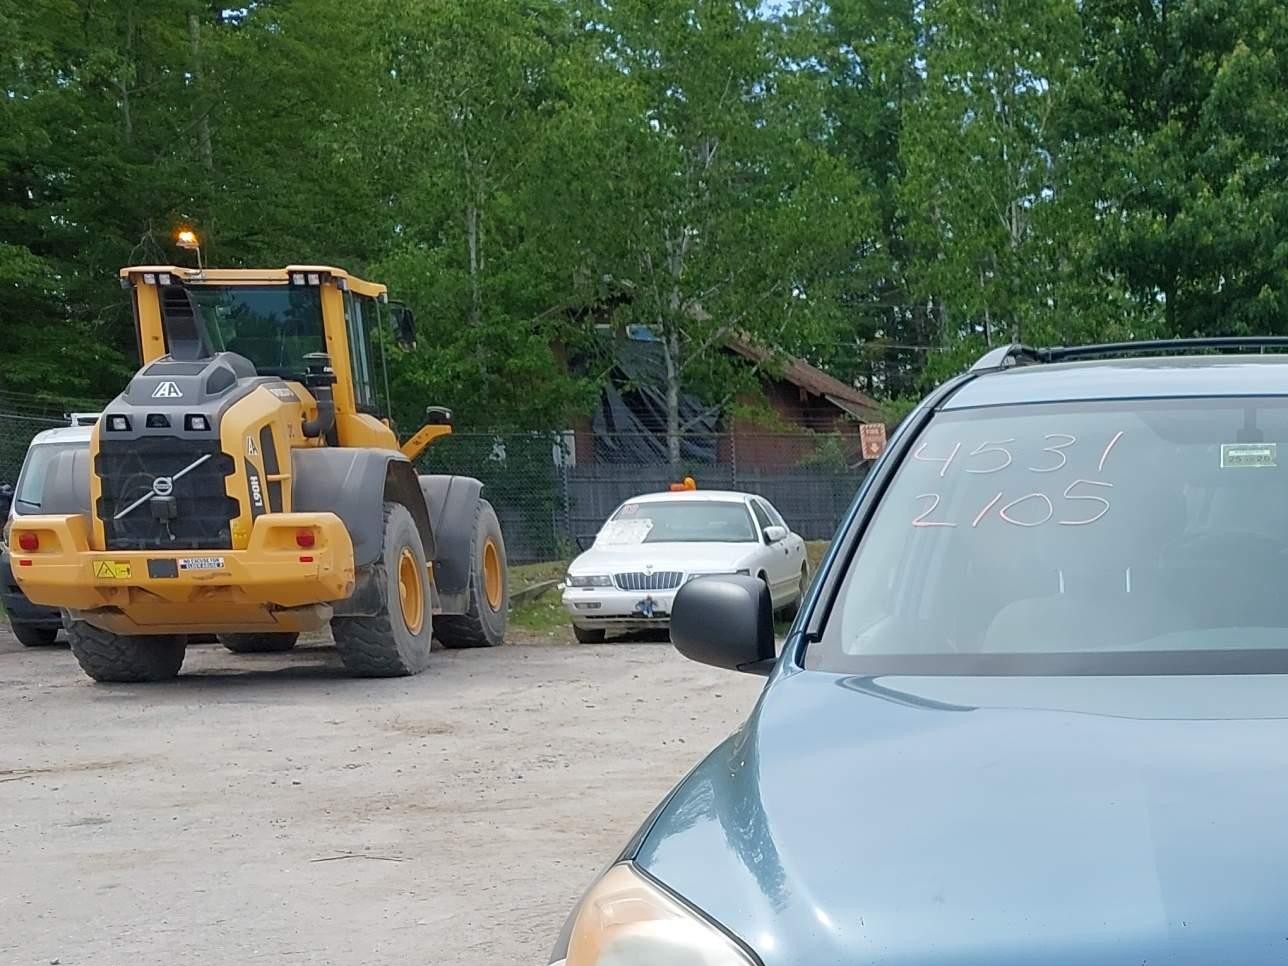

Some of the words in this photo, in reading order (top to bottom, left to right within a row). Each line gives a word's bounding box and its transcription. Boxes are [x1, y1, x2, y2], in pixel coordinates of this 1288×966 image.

[912, 431, 1125, 477] 4531
[249, 475, 263, 507] L90H
[911, 479, 1114, 528] 2105
